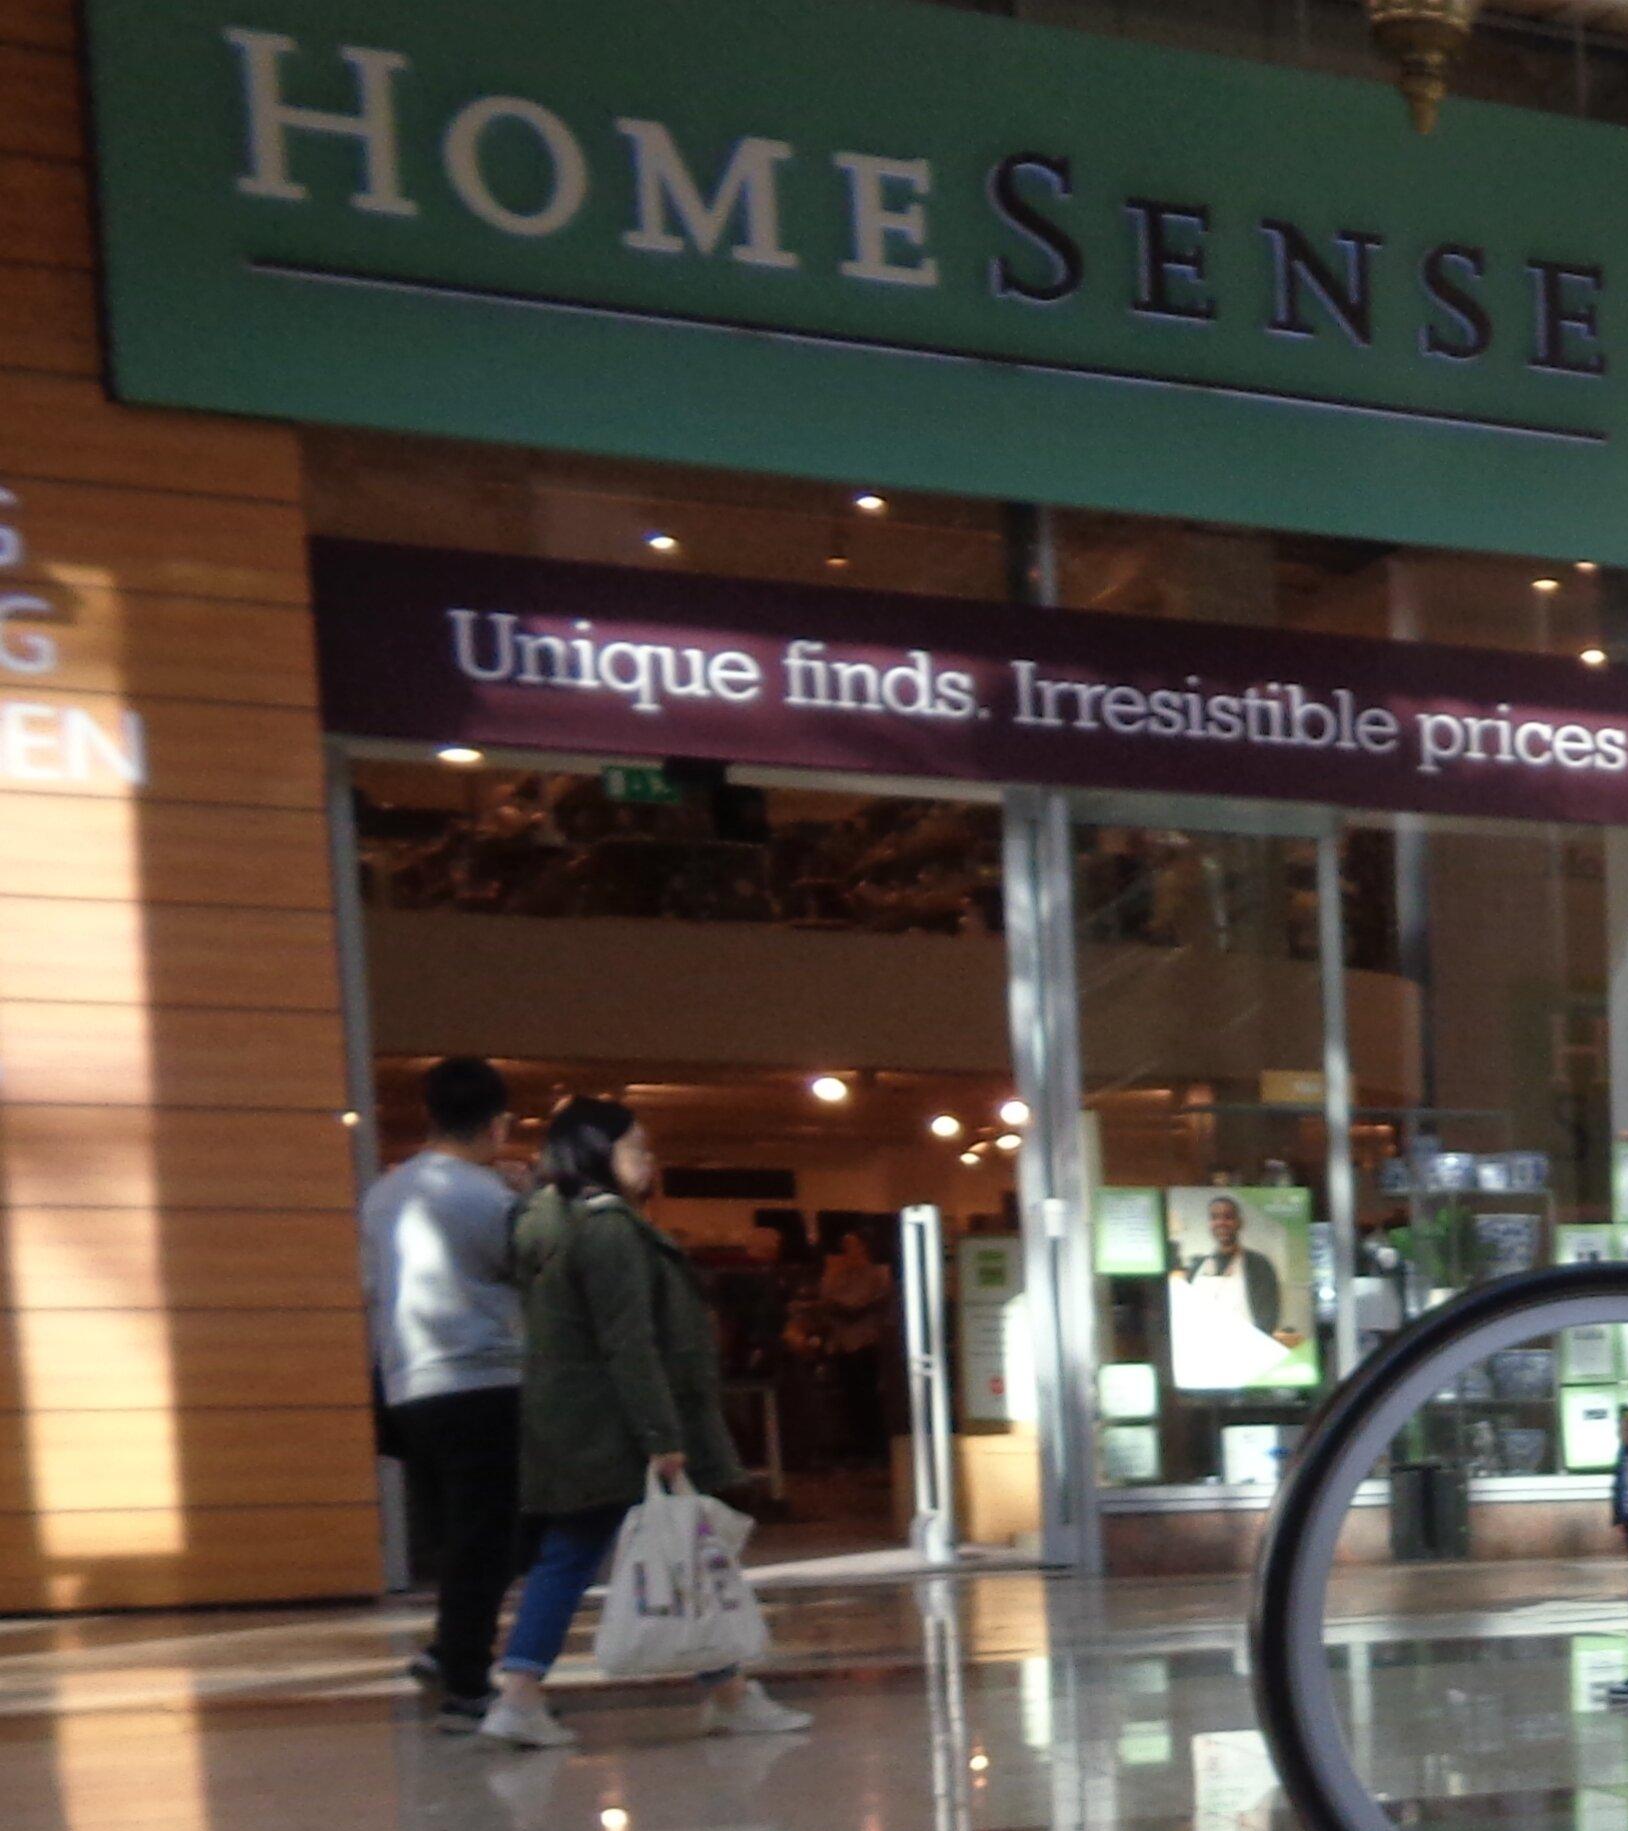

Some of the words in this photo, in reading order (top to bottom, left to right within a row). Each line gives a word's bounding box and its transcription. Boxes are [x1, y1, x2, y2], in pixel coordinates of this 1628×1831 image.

[449, 610, 762, 712] Unique
[783, 640, 989, 720] finds.
[1010, 660, 1398, 754] Irresistible
[1417, 702, 1628, 774] prices
